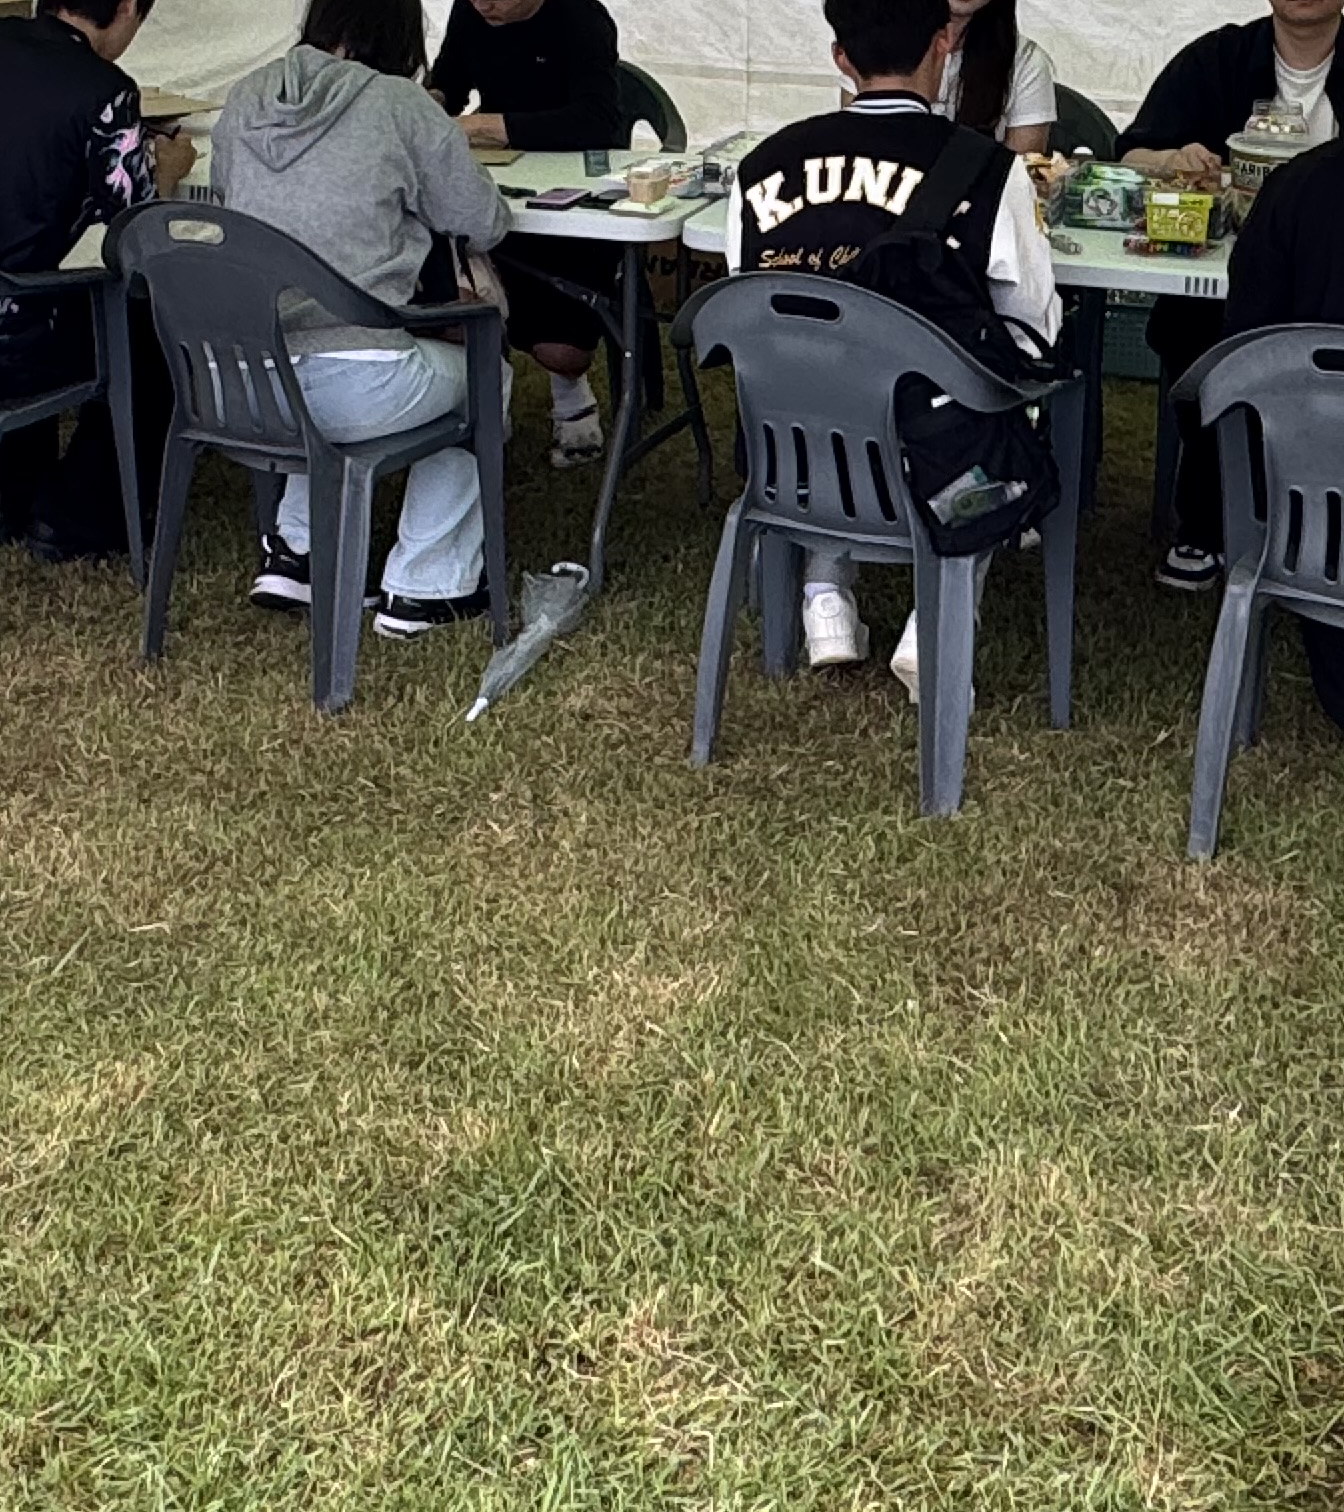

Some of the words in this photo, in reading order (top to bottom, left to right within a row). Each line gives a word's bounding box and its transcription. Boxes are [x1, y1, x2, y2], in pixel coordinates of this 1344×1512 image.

[746, 155, 925, 234] K.UNI
[758, 246, 804, 269] School
[808, 246, 824, 271] of
